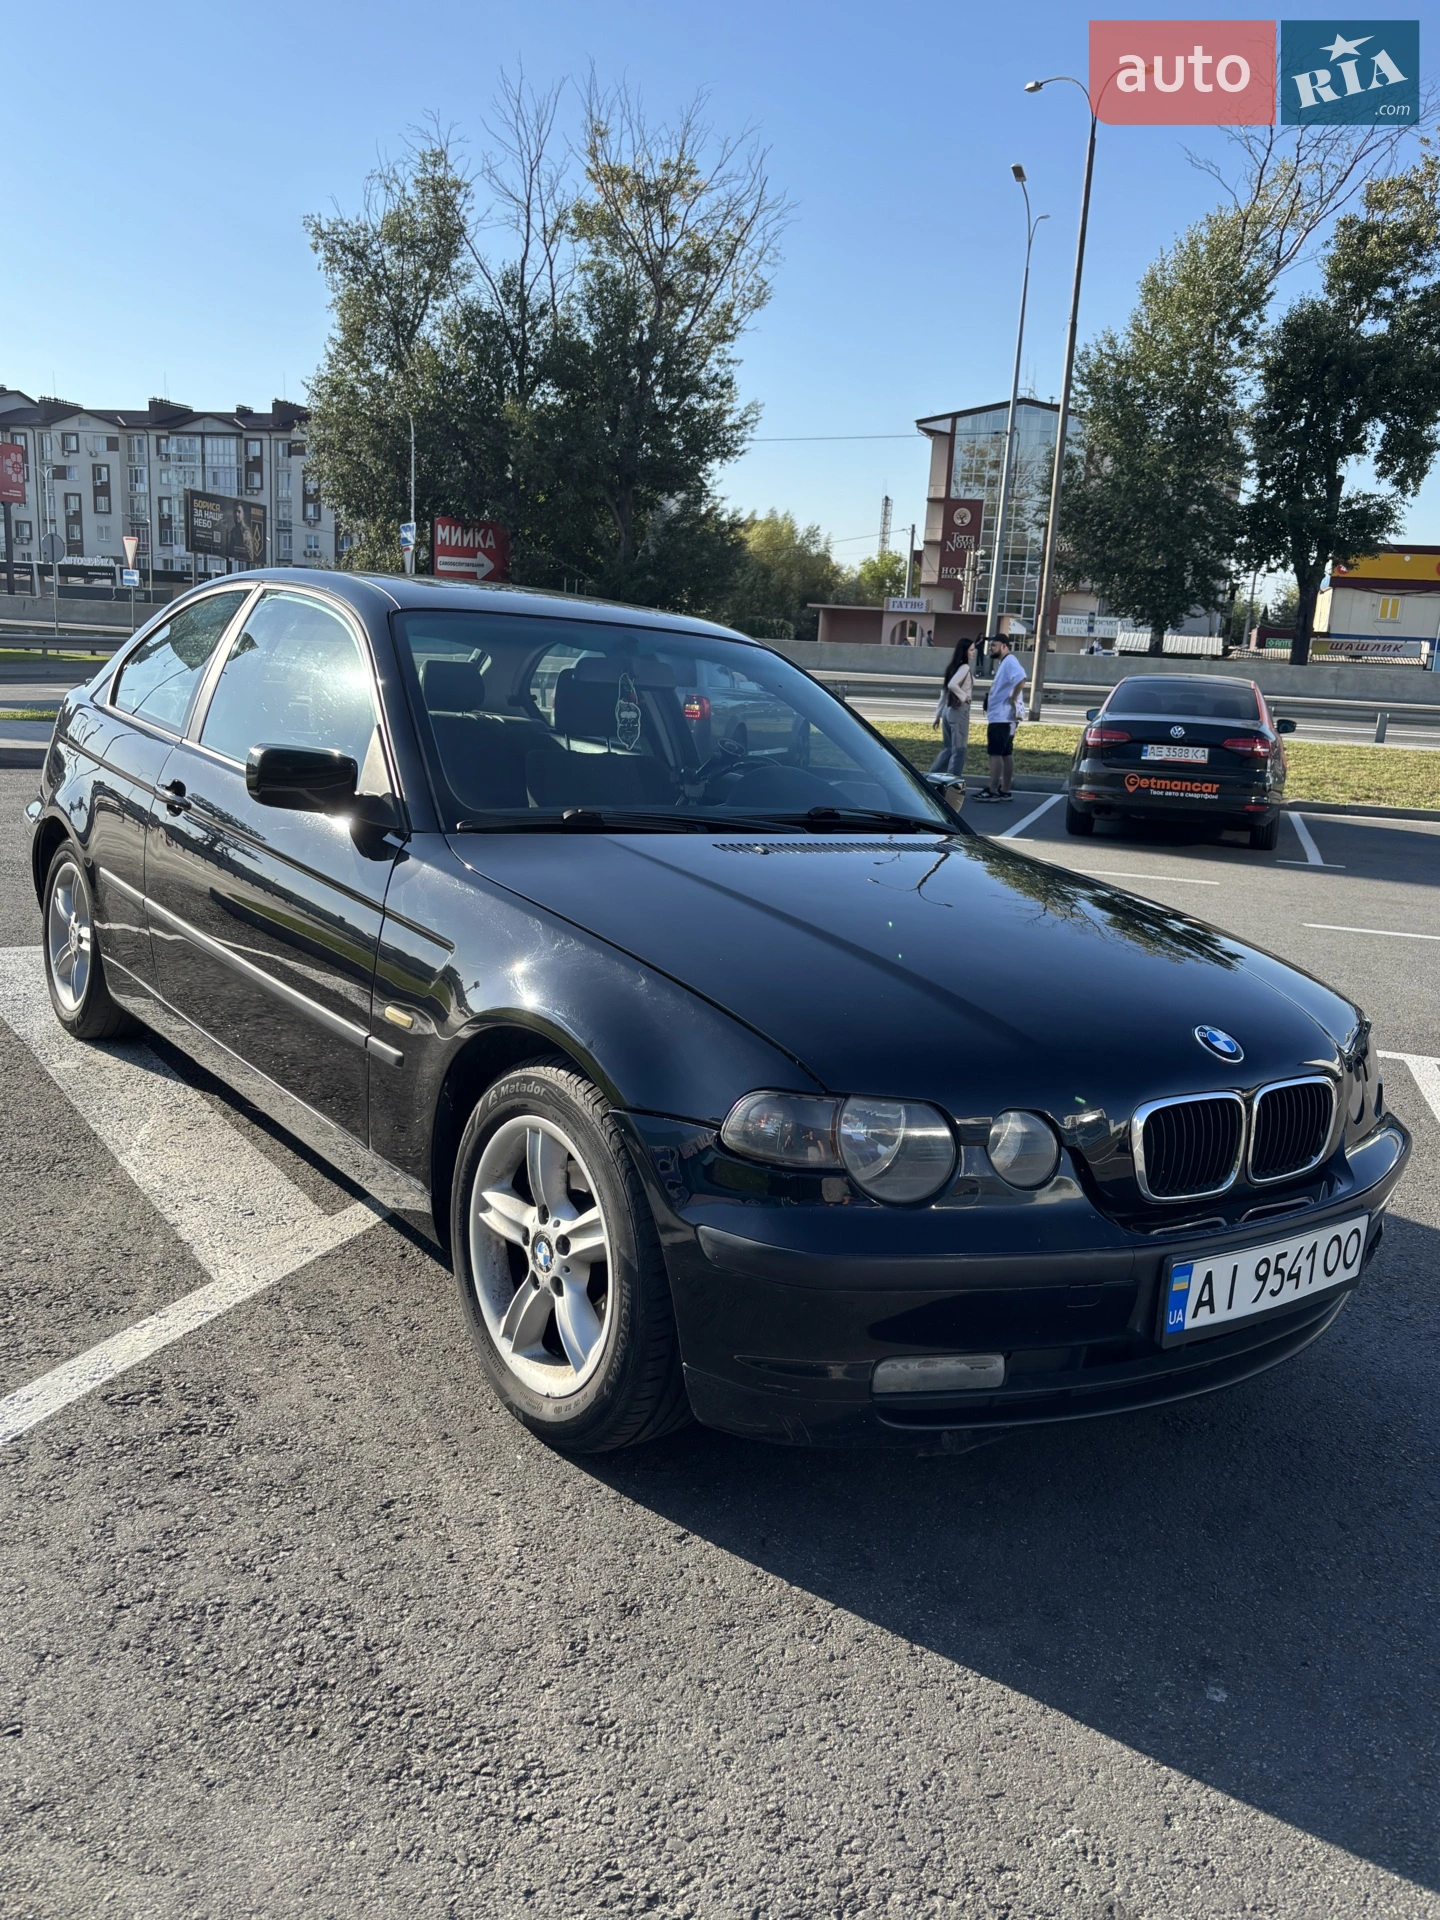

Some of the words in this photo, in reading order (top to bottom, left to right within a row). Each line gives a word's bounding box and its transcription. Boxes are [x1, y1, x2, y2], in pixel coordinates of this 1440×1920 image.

[193, 499, 220, 512] БОРИСЯ
[193, 508, 203, 518] ЗА
[204, 510, 224, 521] НАШЕ
[193, 517, 212, 529] НЕБО
[951, 532, 975, 543] Terra
[1274, 639, 1292, 647] АПТЕ
[1329, 642, 1403, 652] ШАШЛИК
[1148, 746, 1163, 757] AE
[1165, 747, 1189, 758] 3588
[1125, 773, 1219, 793] Getmancar
[500, 1081, 547, 1097] Matador
[1169, 1308, 1184, 1325] UA
